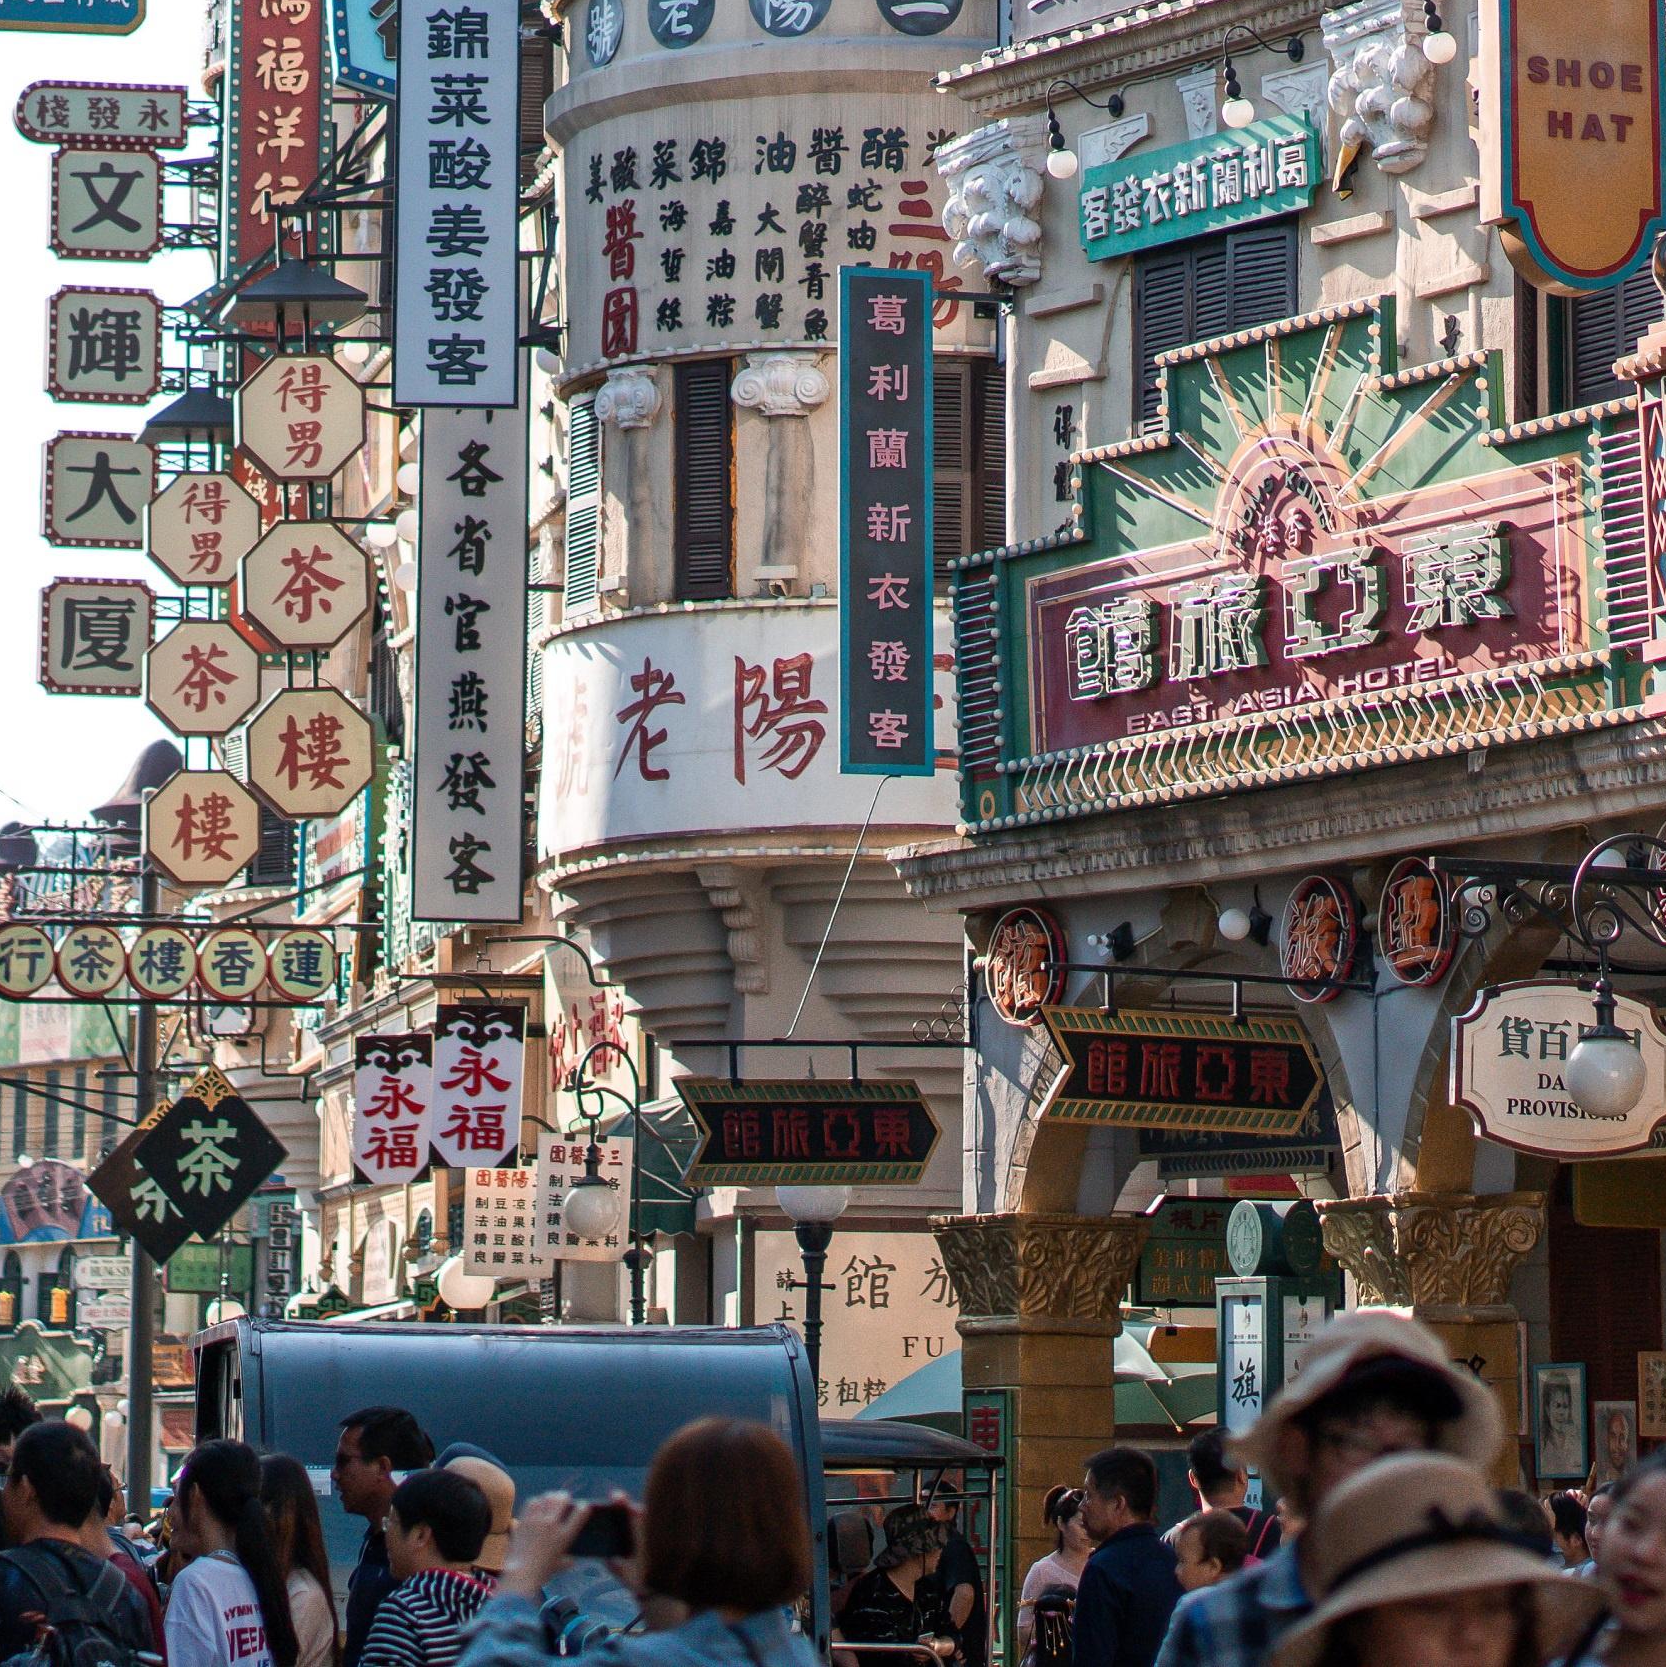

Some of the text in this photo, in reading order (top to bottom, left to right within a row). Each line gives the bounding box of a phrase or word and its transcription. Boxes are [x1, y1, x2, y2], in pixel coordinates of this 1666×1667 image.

[36, 96, 170, 132] 永發棧
[1527, 54, 1644, 94] SHOE
[1547, 108, 1634, 143] HAT
[754, 202, 787, 330] 大閘蟹
[866, 294, 912, 750] 葛利蘭新衣發客
[271, 364, 351, 793] 得男茶樓
[171, 481, 239, 863] 得男茶樓
[1125, 655, 1462, 736] EAST ASIA HOTEL
[440, 1048, 511, 1152] 永福
[1086, 1039, 1292, 1105] 東亞旅館
[177, 1120, 241, 1196] 茶
[362, 1076, 426, 1171] 永福
[722, 1108, 913, 1159] 東亞旅館
